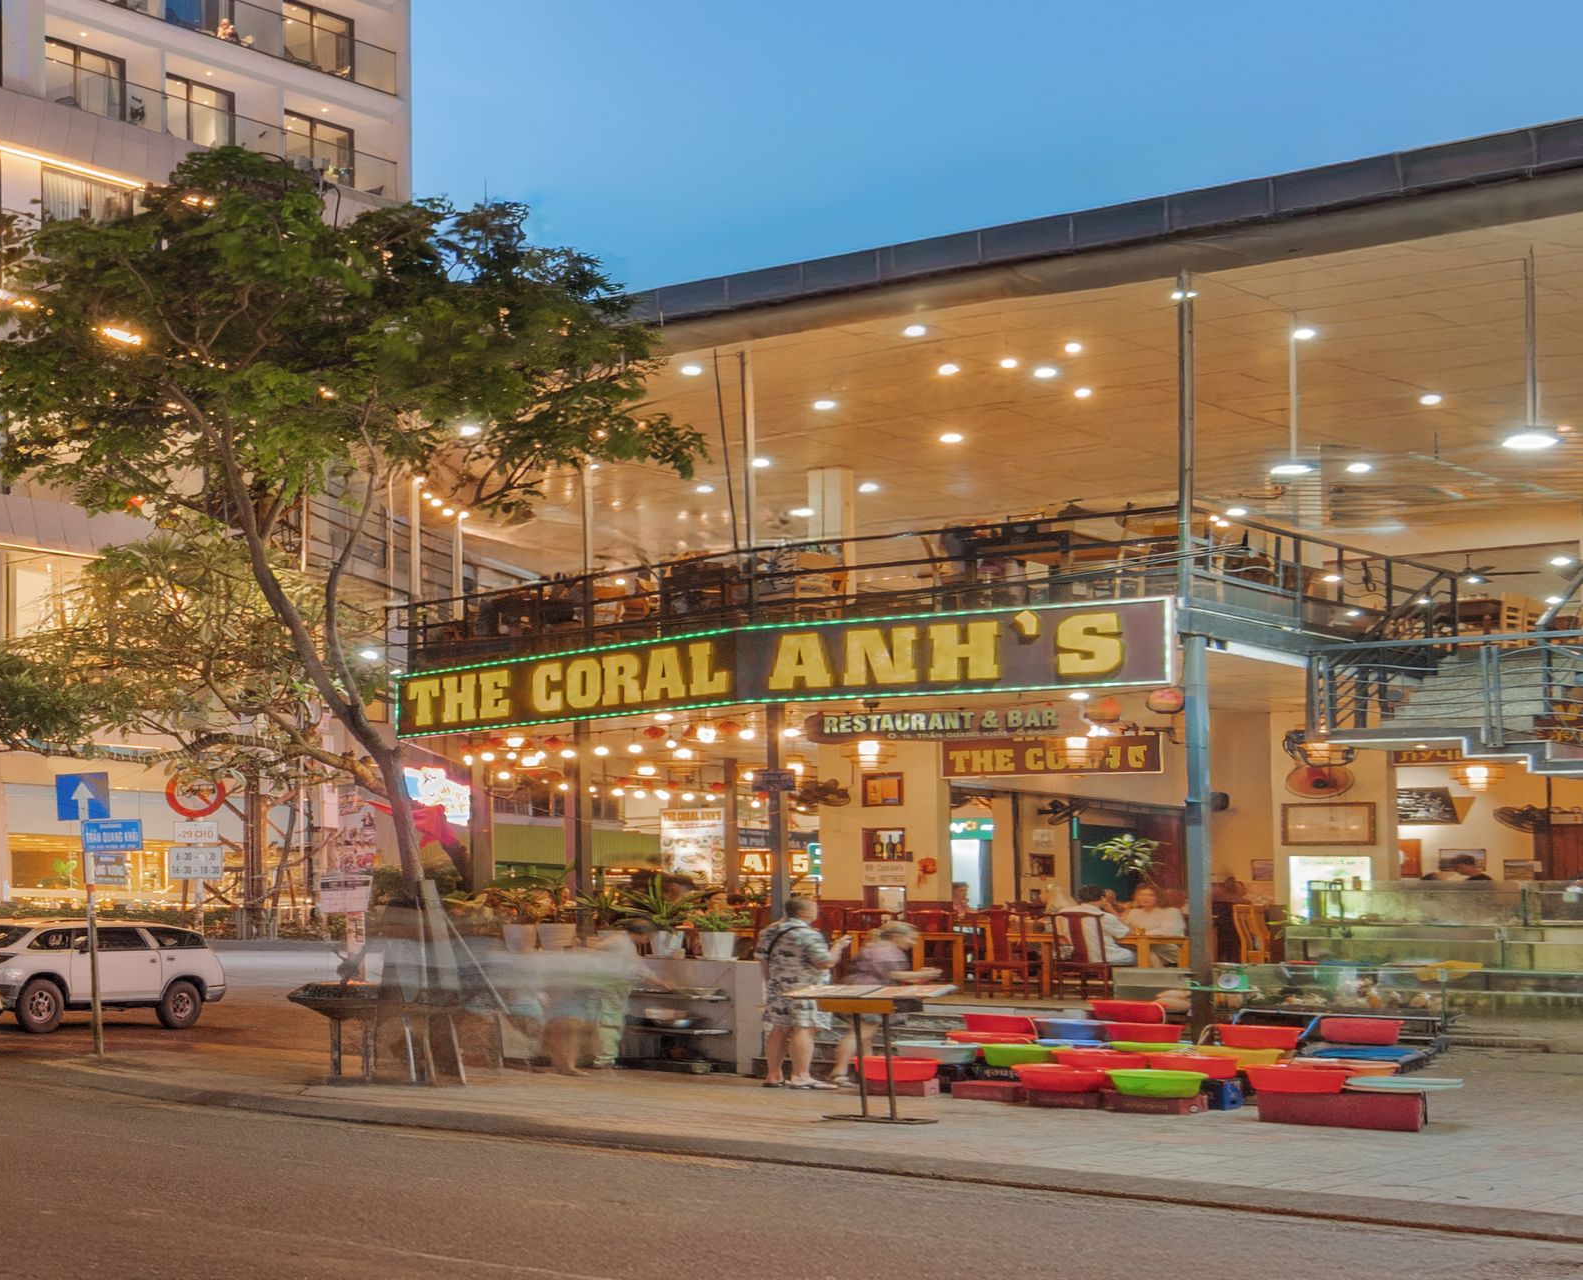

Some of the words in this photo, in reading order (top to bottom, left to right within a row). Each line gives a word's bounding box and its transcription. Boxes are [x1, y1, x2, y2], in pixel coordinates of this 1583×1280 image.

[408, 669, 512, 726] THE
[532, 641, 732, 713] CORAL
[767, 609, 1125, 691] ANH'S
[822, 711, 975, 734] RESTAURANT
[980, 710, 999, 729] &
[1007, 709, 1059, 728] BAR
[949, 748, 1015, 773] THE
